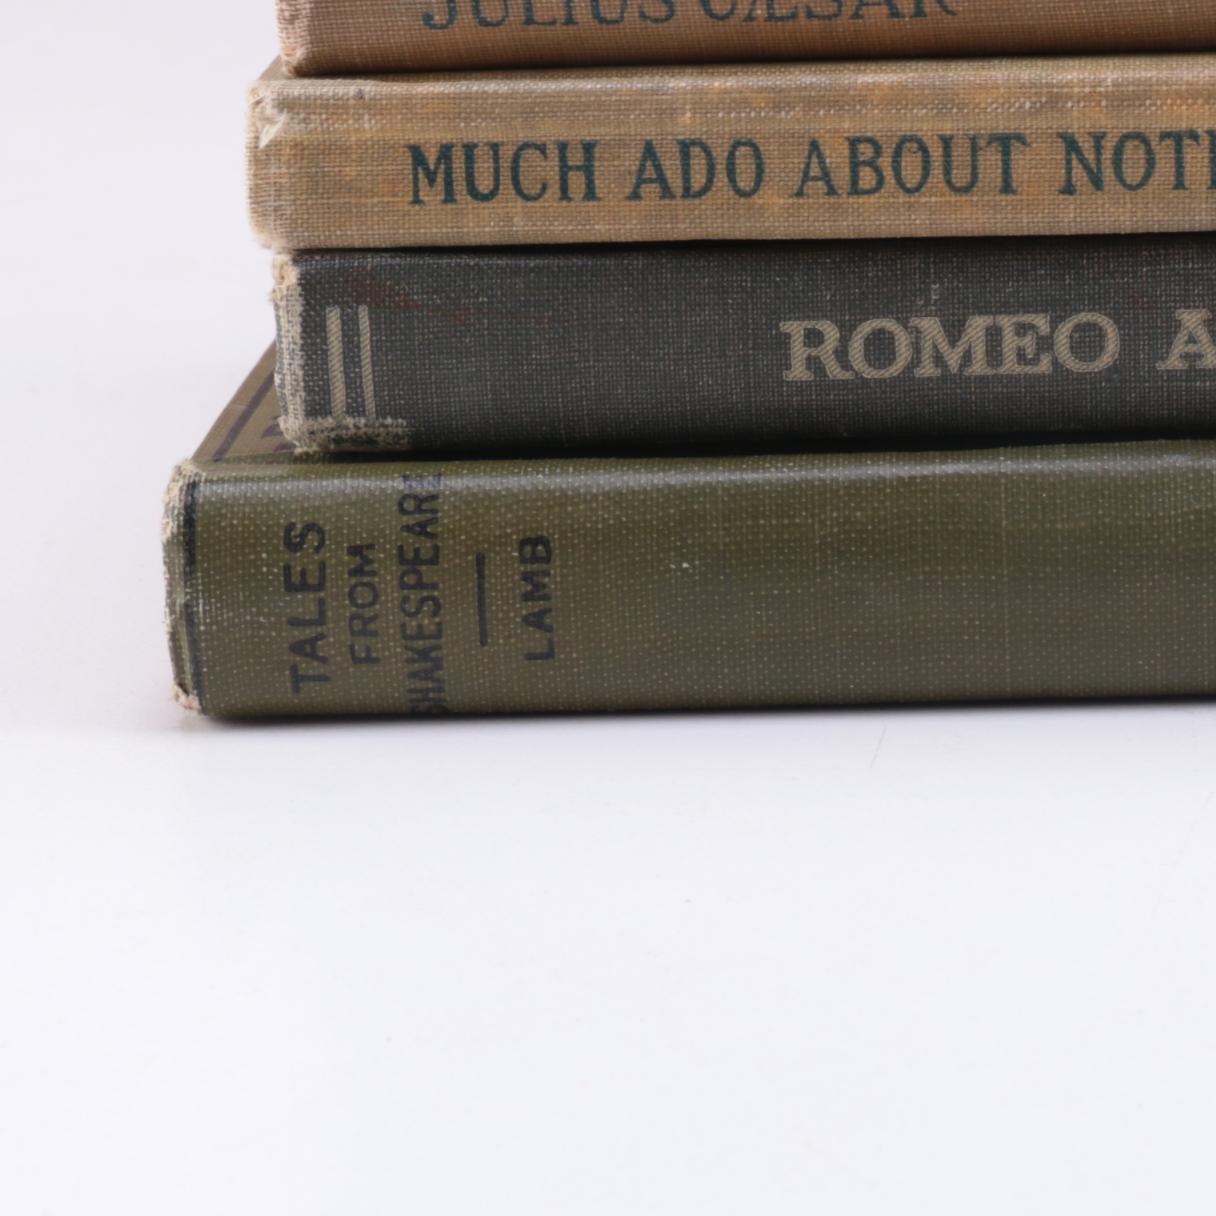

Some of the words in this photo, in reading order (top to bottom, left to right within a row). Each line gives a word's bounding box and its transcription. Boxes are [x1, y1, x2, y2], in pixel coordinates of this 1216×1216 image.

[408, 141, 600, 206] MUCH
[626, 137, 767, 200] ADO
[794, 131, 1031, 198] ABOUT
[779, 312, 1122, 383] ROMEO
[283, 521, 330, 694] TALES
[347, 543, 380, 665] FROM
[519, 535, 555, 662] LAMB
